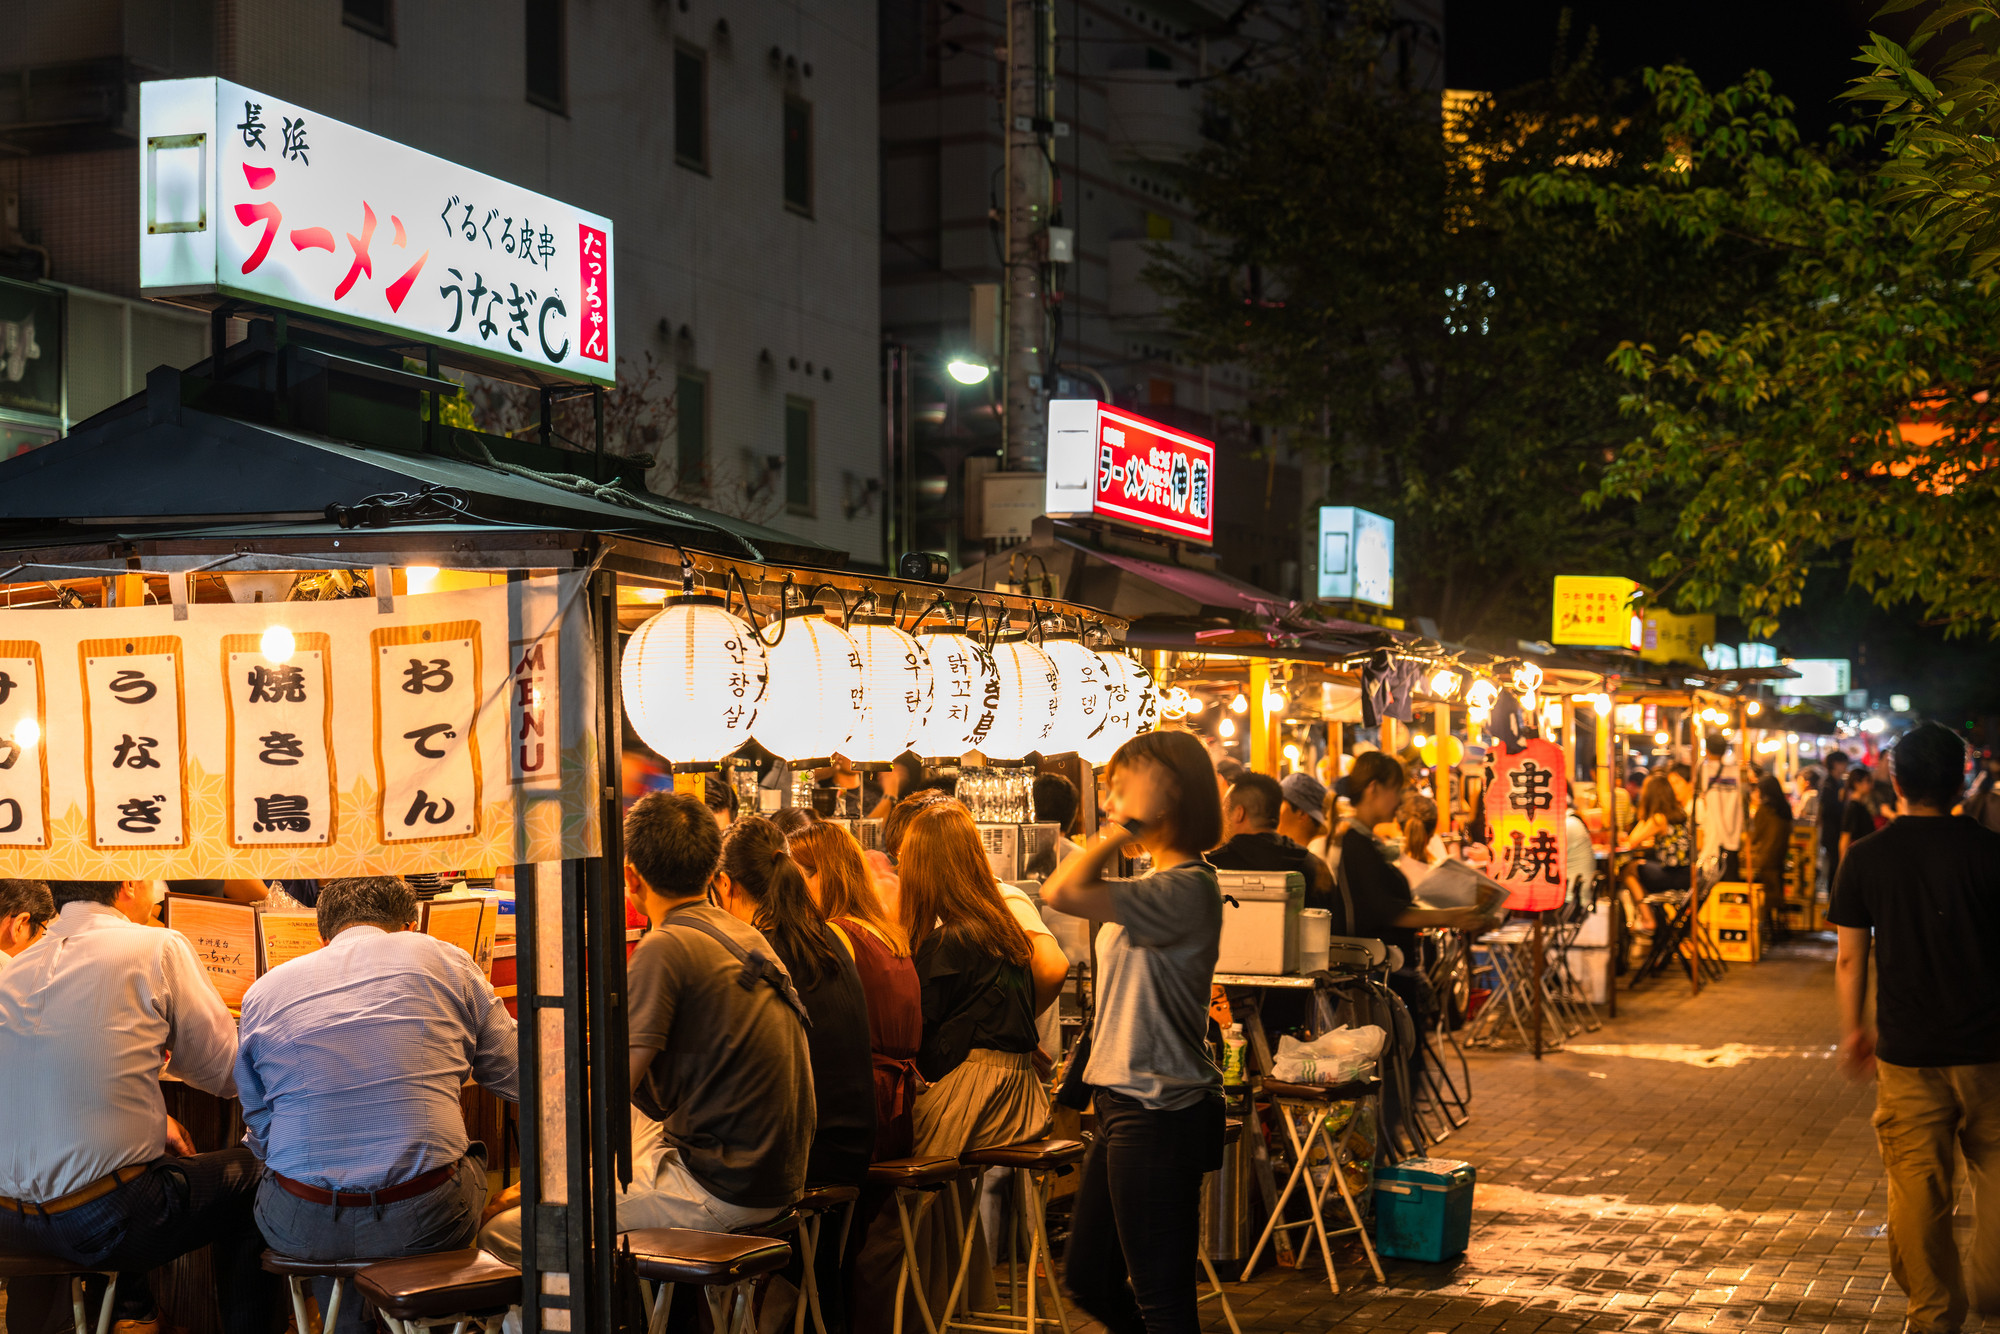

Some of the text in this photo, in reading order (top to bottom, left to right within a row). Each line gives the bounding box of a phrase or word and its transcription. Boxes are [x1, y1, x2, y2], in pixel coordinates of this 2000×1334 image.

[237, 100, 310, 167] 長浜
[234, 162, 430, 314] ラーメン
[441, 194, 556, 272] ぐるぐる皮串
[583, 231, 604, 357] たっちゃん
[515, 643, 546, 772] MENU
[723, 637, 750, 728] 안창살
[847, 651, 864, 710] 라면
[947, 653, 971, 722] 닭꼬치
[1081, 667, 1098, 715] 오뎅
[1111, 684, 1129, 728] 장어
[108, 669, 167, 834] うなぎ
[247, 664, 311, 833] 焼き鳥
[402, 658, 455, 827] おでん
[1503, 761, 1561, 885] 串焼
[198, 949, 244, 966] っちゃん
